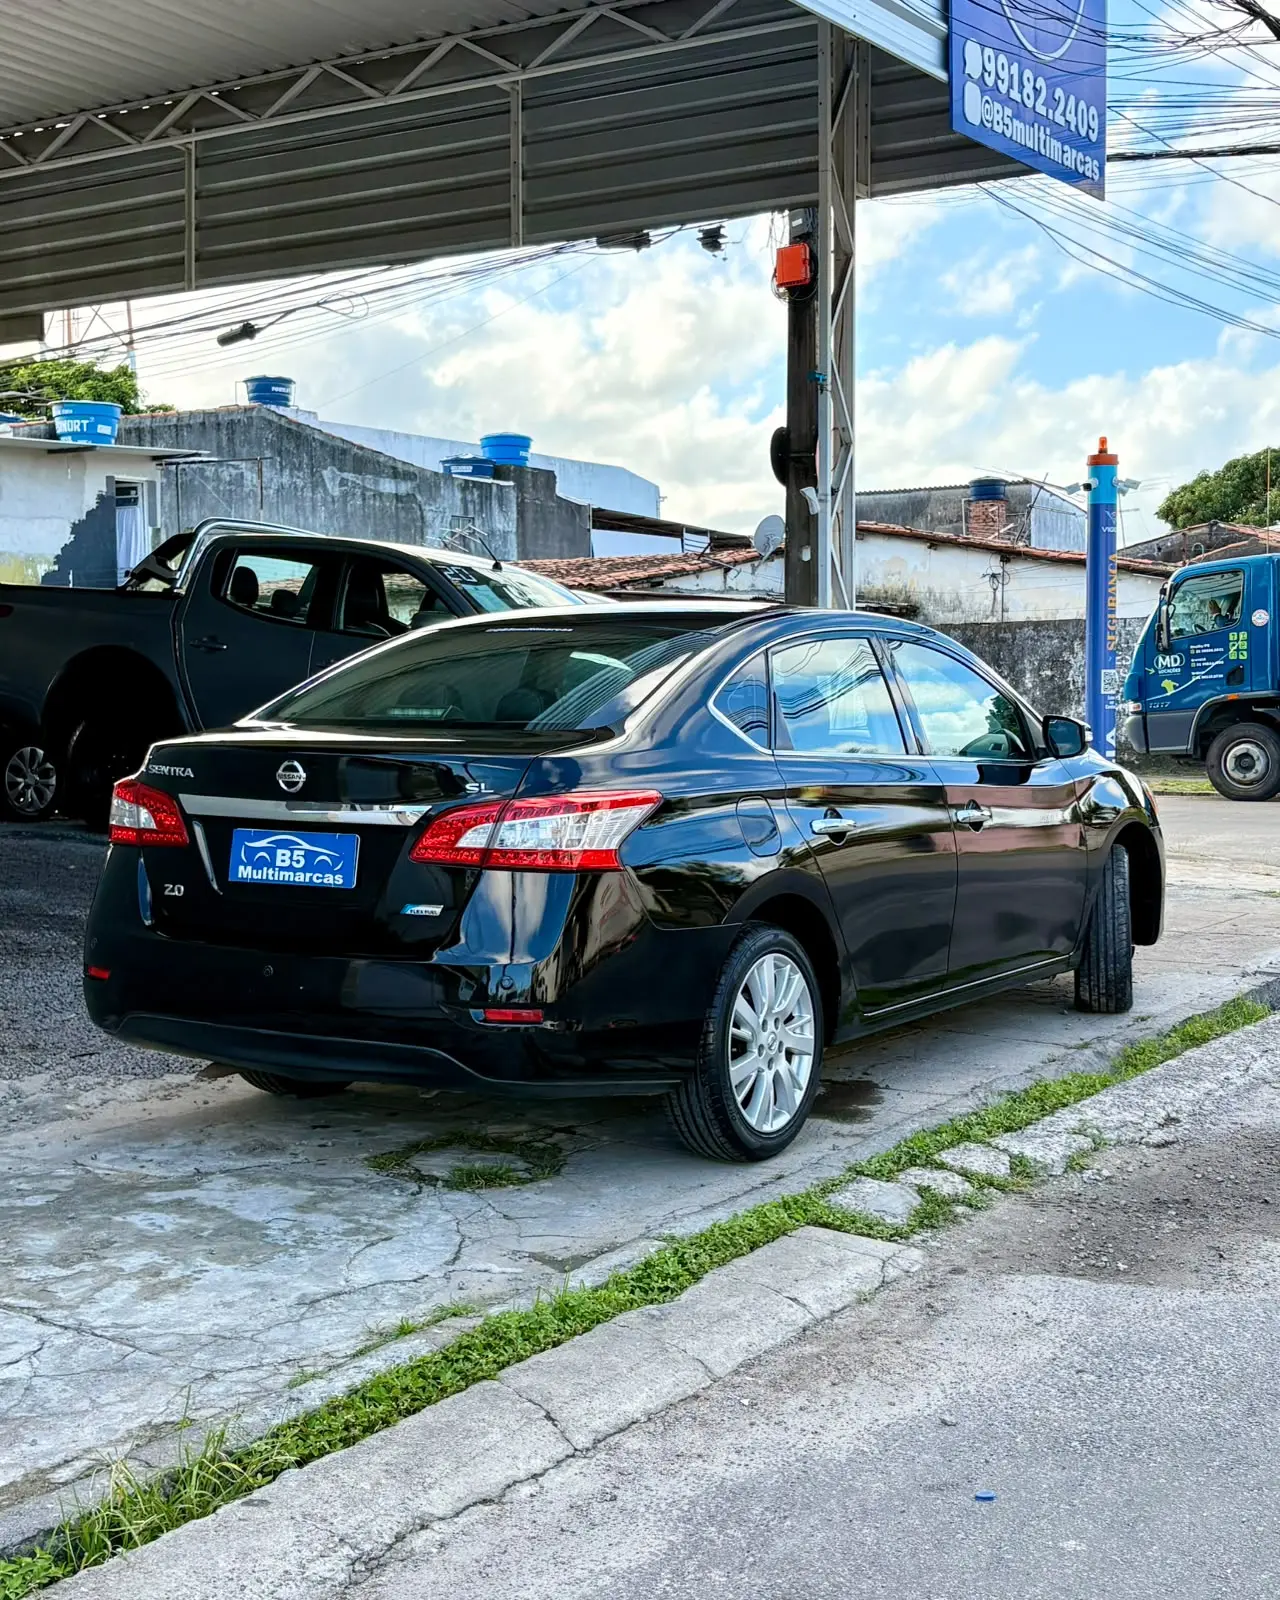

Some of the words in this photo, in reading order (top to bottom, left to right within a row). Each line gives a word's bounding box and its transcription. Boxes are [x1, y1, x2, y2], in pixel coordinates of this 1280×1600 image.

[983, 47, 1099, 143] 99182.2409
[981, 95, 1100, 182] @B5multimarcas
[148, 764, 195, 778] SENTRA
[278, 773, 303, 781] NISSAN
[465, 782, 495, 794] SL
[275, 849, 306, 868] B5
[238, 865, 344, 885] Multimarcas
